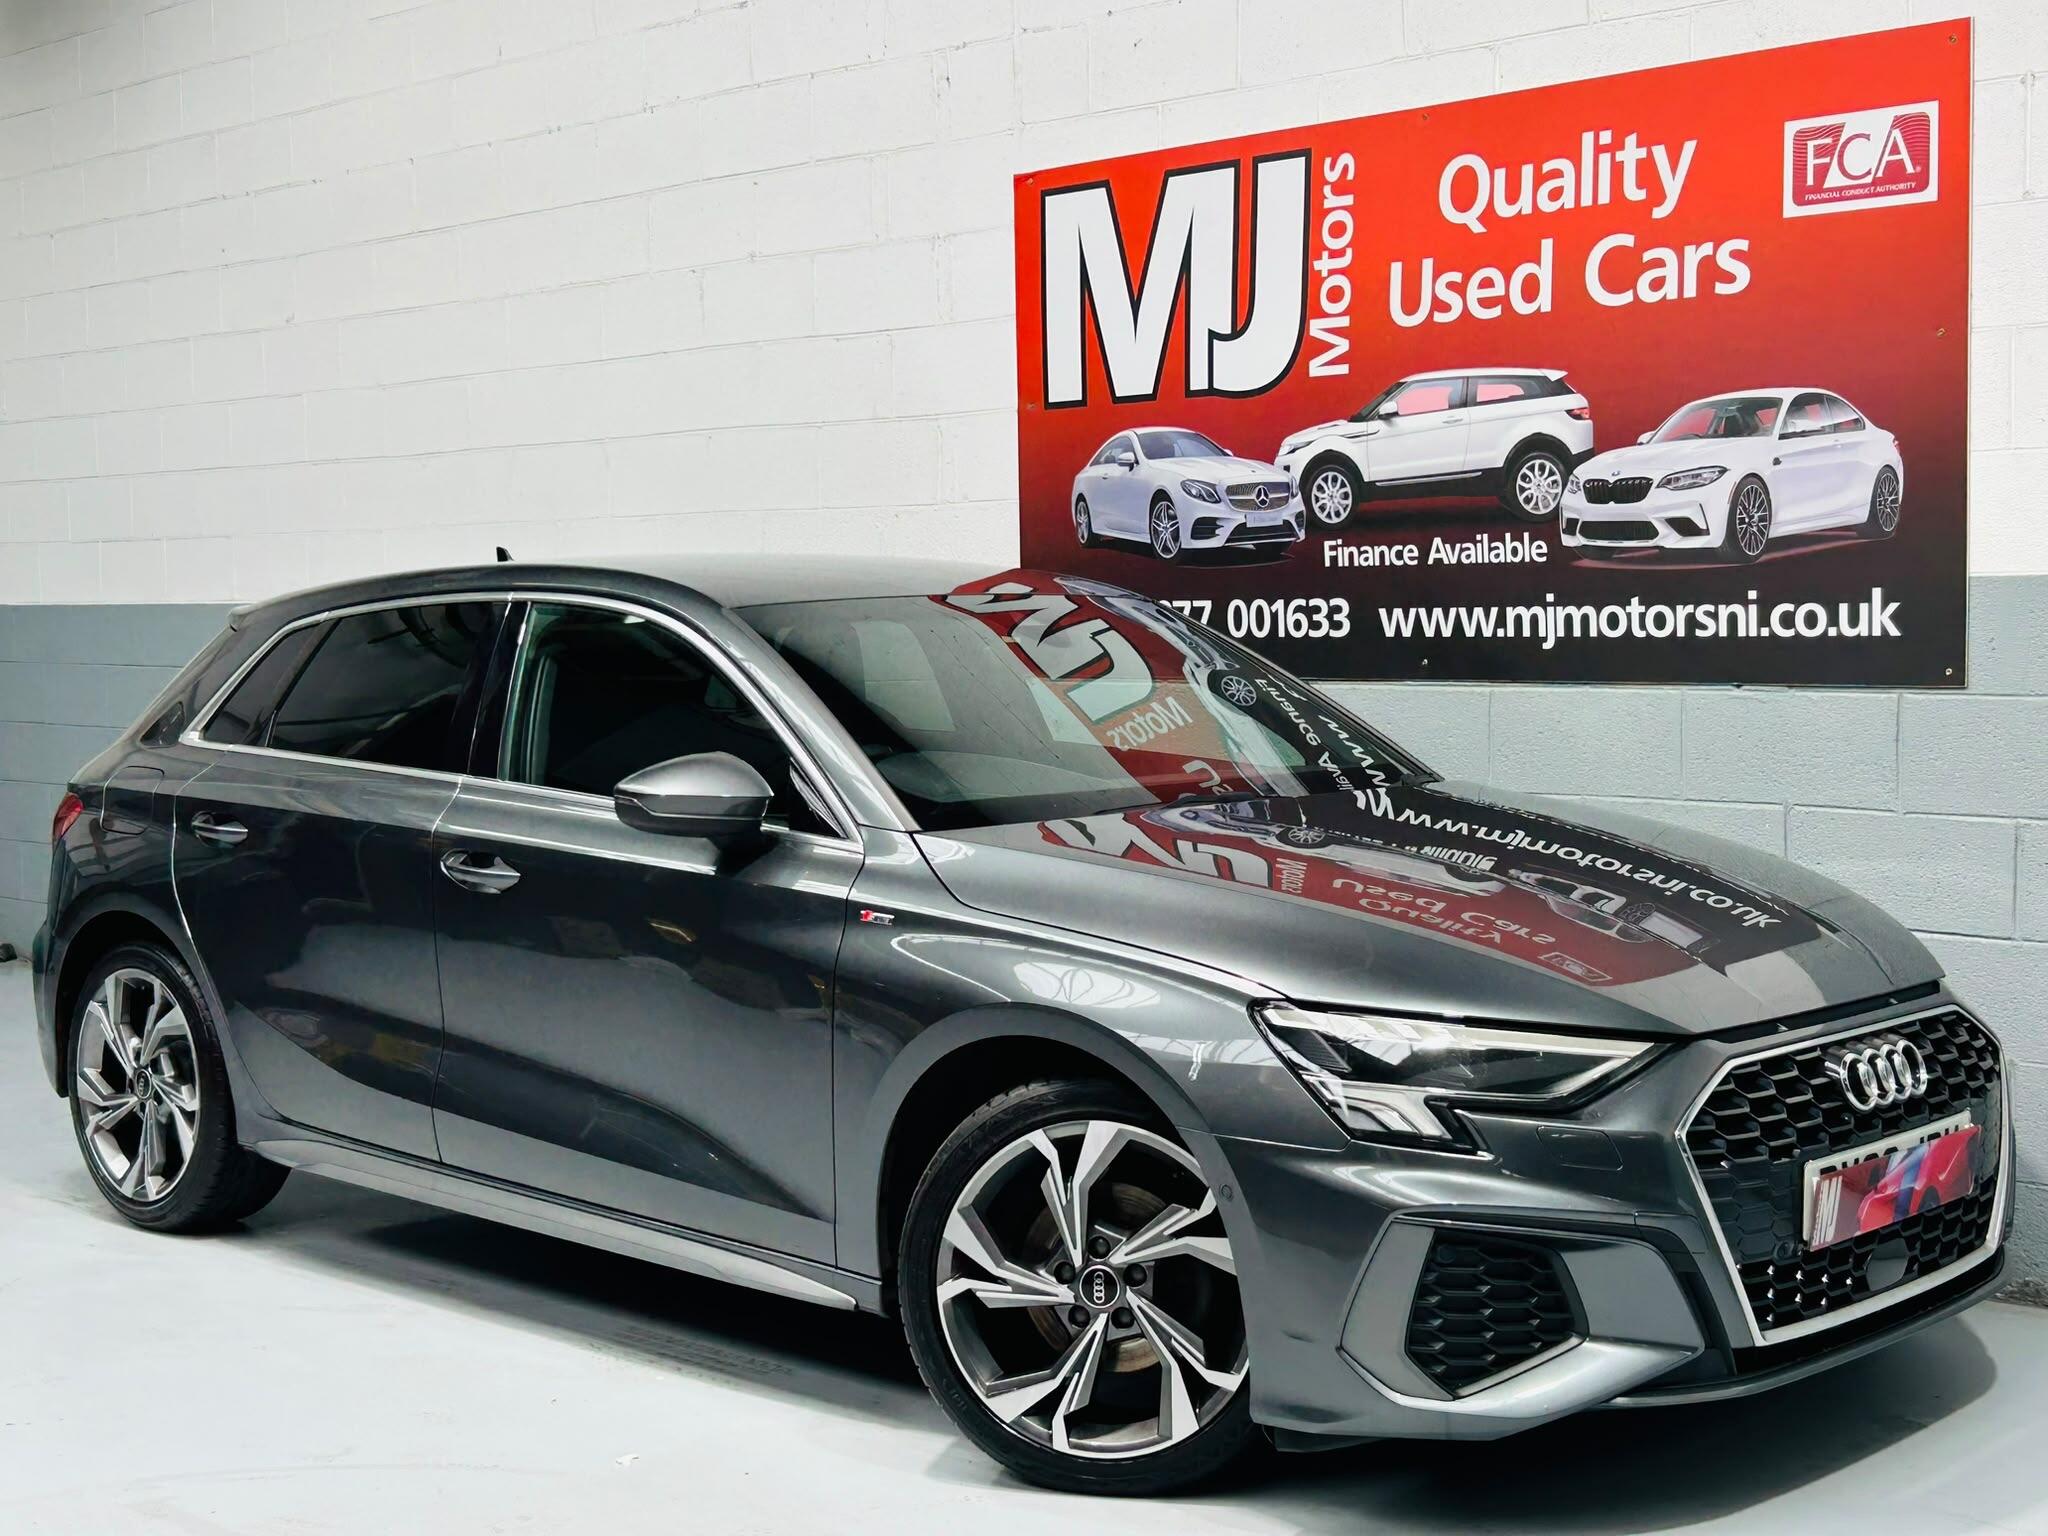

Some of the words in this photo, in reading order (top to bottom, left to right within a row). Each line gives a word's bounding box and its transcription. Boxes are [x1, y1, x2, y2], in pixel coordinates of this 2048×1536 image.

[1438, 129, 1698, 234] Quality
[1806, 128, 1916, 187] FCA
[1804, 190, 1841, 201] FINANCIAL
[1841, 186, 1875, 197] CONDUCT
[1875, 181, 1916, 193] AUTHORITY
[1041, 148, 1312, 410] MJ
[1308, 152, 1355, 378] Motors
[1388, 238, 1554, 328] Used
[1584, 232, 1751, 307] Cars
[1322, 538, 1419, 567] Finance
[1427, 534, 1548, 564] Available
[1226, 597, 1350, 638] 001633
[1378, 587, 1901, 650] www.mjmotorsni.co.uk
